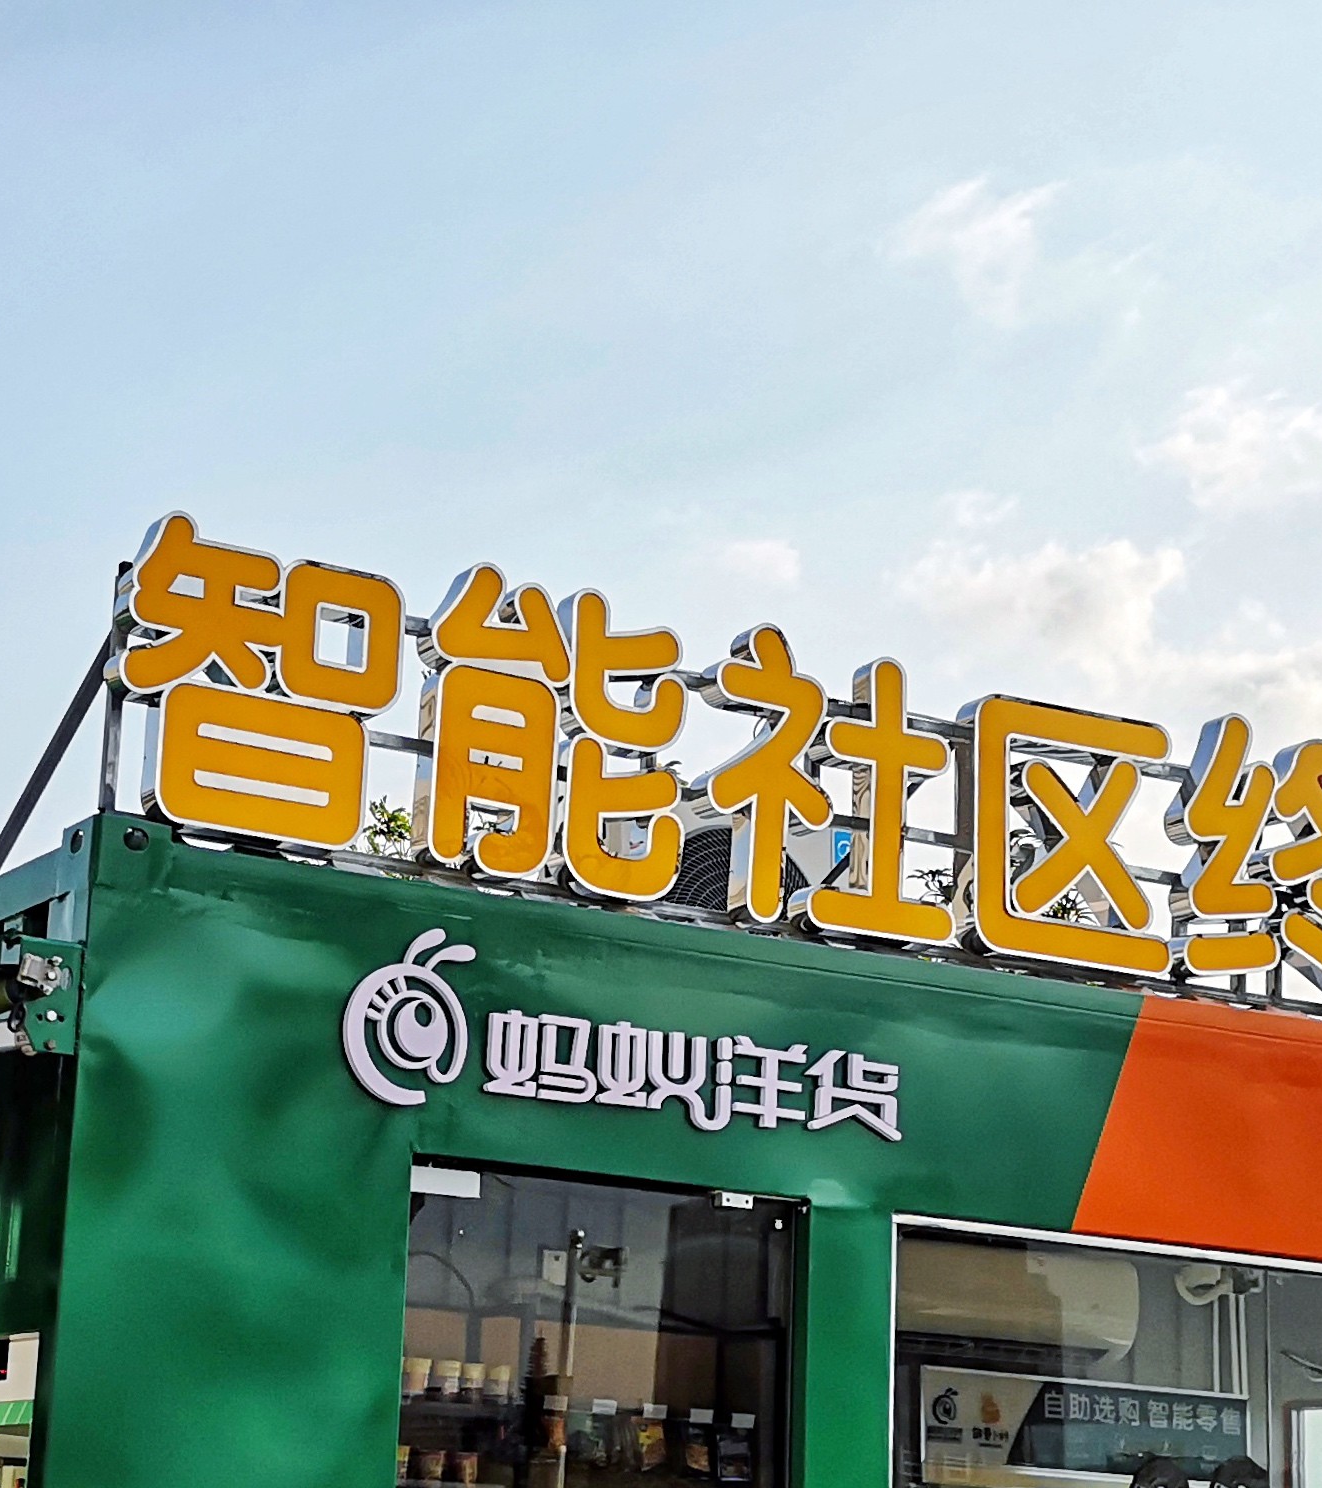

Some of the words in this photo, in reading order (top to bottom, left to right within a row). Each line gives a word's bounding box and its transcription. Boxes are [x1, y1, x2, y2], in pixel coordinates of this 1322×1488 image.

[483, 1007, 903, 1143] 蚂蚁洋货
[1044, 1390, 1141, 1427] 自助选购
[1147, 1399, 1242, 1436] 智能零售
